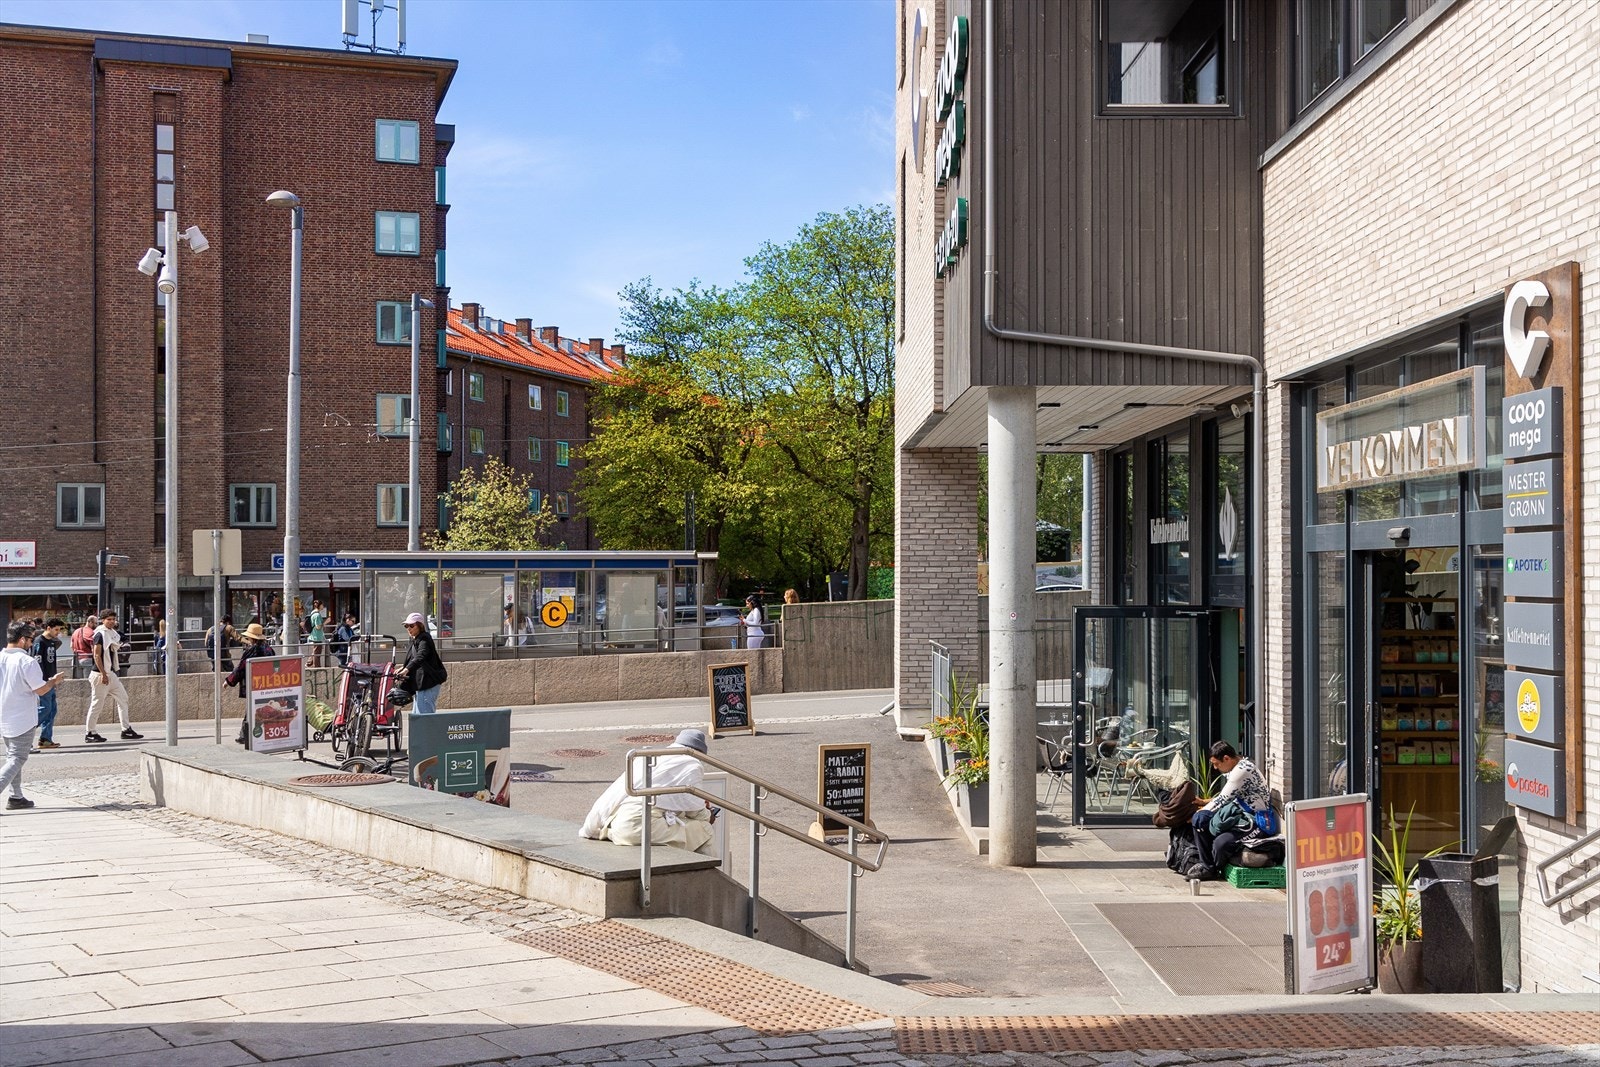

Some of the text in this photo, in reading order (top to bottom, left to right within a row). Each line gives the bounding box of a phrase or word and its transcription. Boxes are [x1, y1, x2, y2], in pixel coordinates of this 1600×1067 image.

[1508, 400, 1545, 424] coop
[1509, 428, 1541, 451] mega
[1326, 416, 1468, 482] VELKOMMEN
[1508, 471, 1546, 491] MESTER
[1509, 499, 1545, 517] GRØNN
[1514, 559, 1543, 571] APOTEK
[252, 672, 300, 689] TILBUD
[266, 726, 289, 738] -30%
[447, 723, 475, 731] MESTER
[450, 760, 458, 770] 3
[466, 759, 473, 769] 2
[836, 766, 865, 777] RABATT
[826, 788, 864, 800] 50% RABATT
[1519, 778, 1549, 798] posten
[1297, 831, 1364, 864] TILBUD
[1302, 870, 1316, 878] Coop
